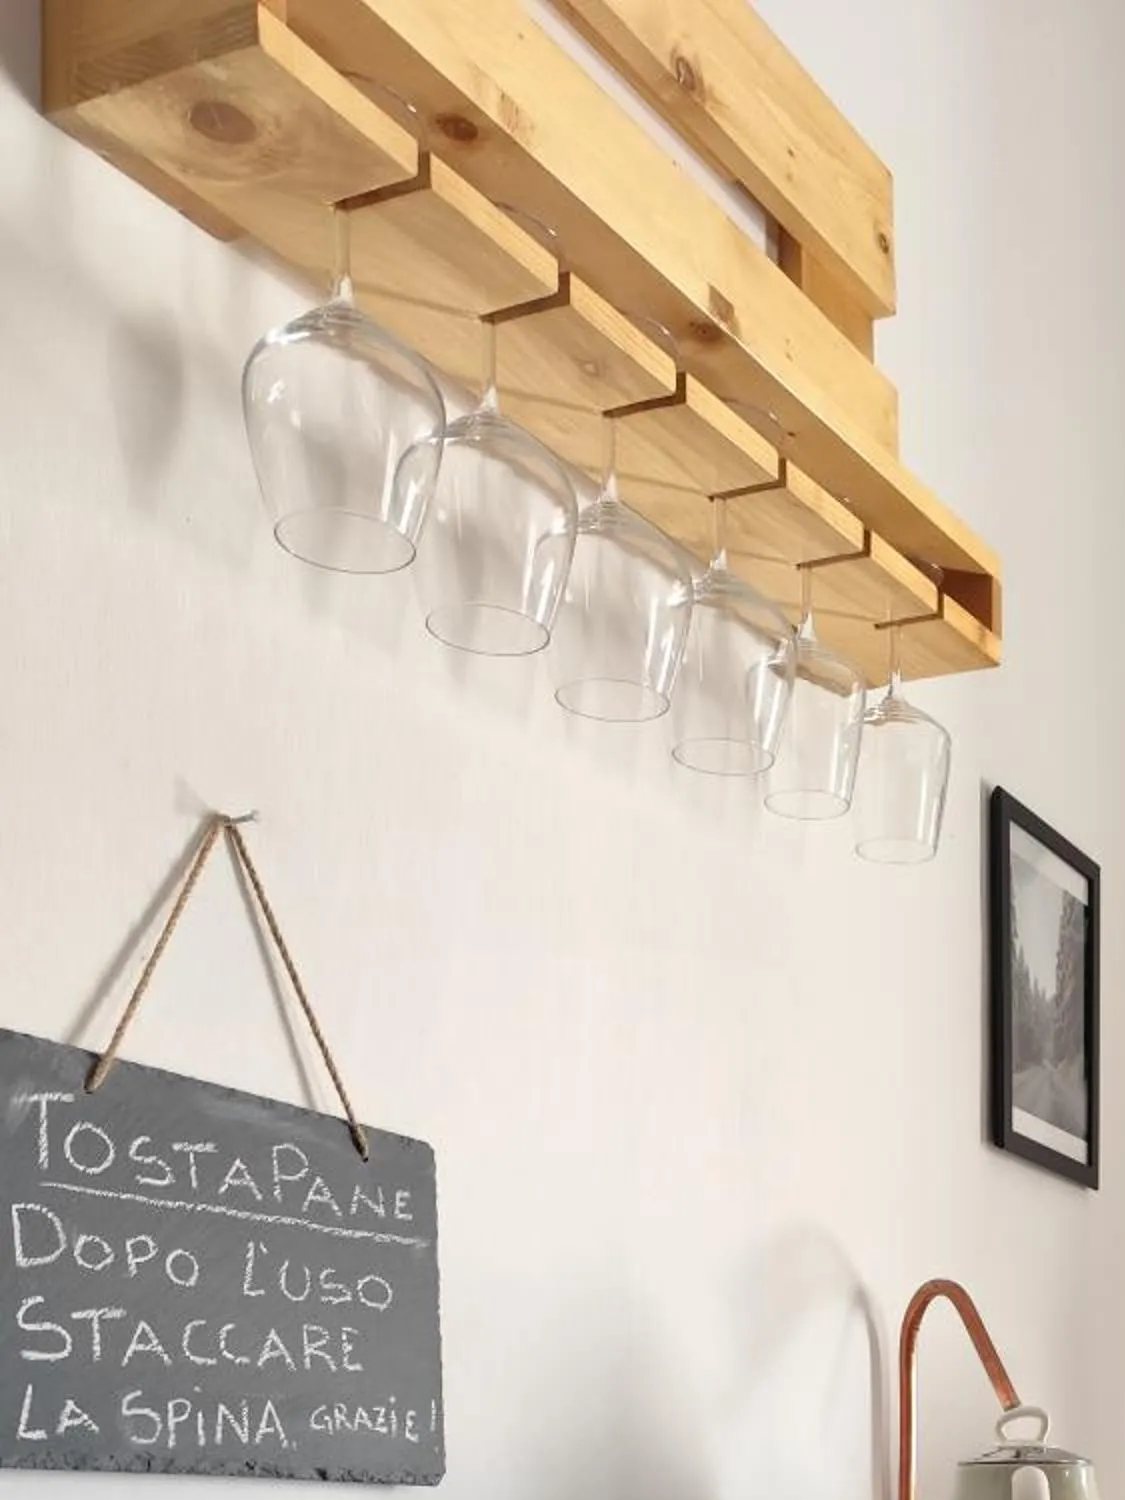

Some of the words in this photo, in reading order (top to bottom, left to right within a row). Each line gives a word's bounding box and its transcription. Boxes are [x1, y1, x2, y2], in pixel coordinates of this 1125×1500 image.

[17, 1091, 414, 1221] TOSTAPANE
[11, 1202, 200, 1288] DOPO
[242, 1240, 394, 1311] L'USO
[15, 1295, 364, 1372] STACCARE
[16, 1383, 100, 1442] LA
